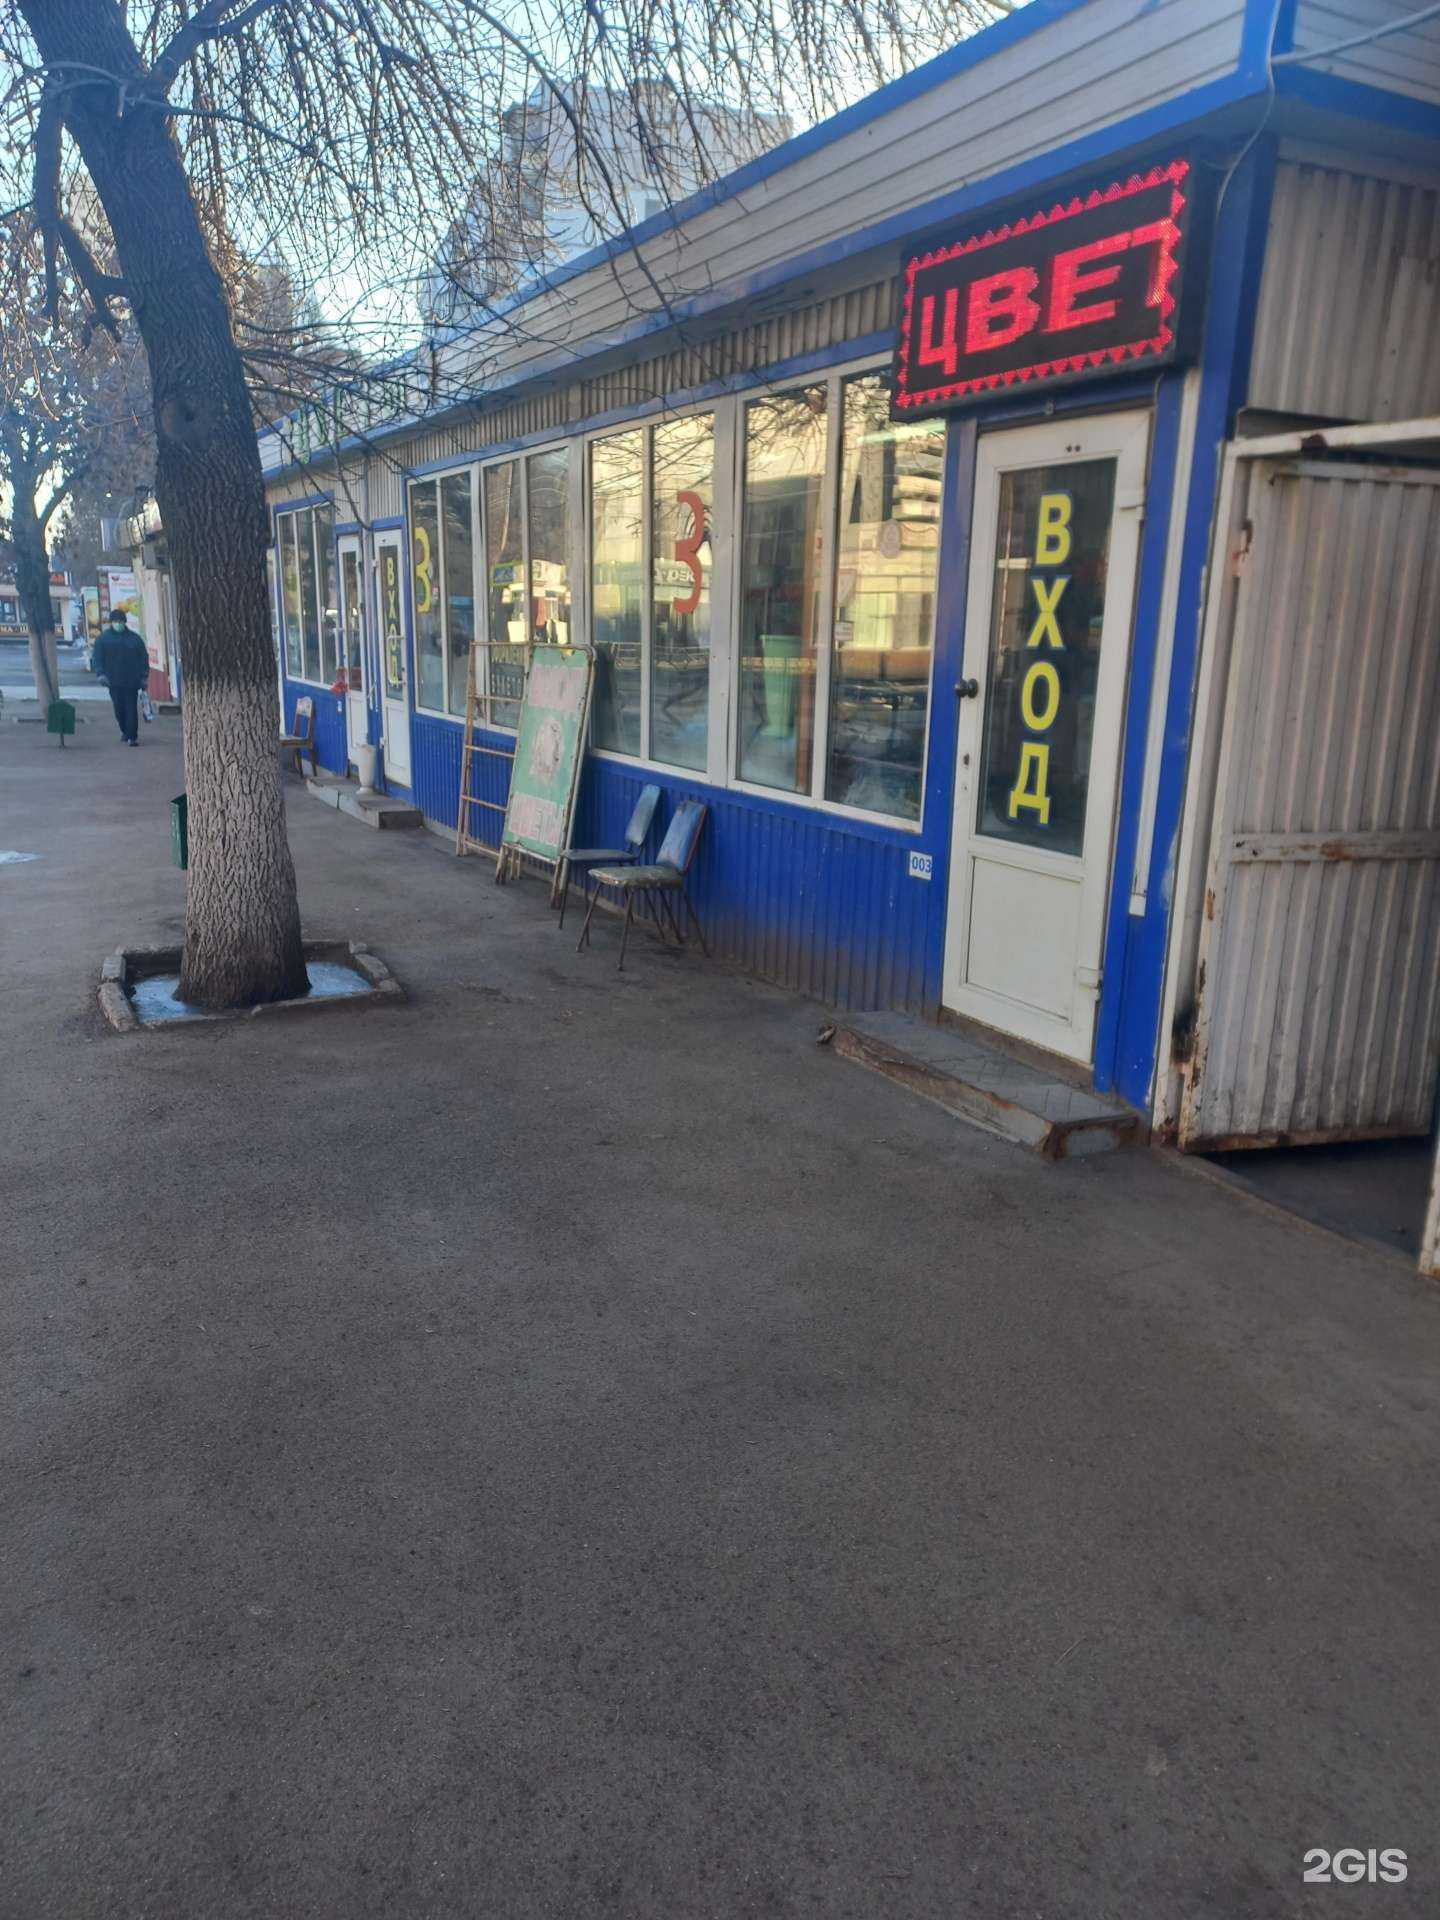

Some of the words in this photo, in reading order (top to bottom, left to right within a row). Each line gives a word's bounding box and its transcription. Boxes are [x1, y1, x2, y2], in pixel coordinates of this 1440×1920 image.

[386, 556, 399, 688] ВХОД
[1007, 492, 1073, 826] ВХОД
[912, 856, 932, 873] 003
